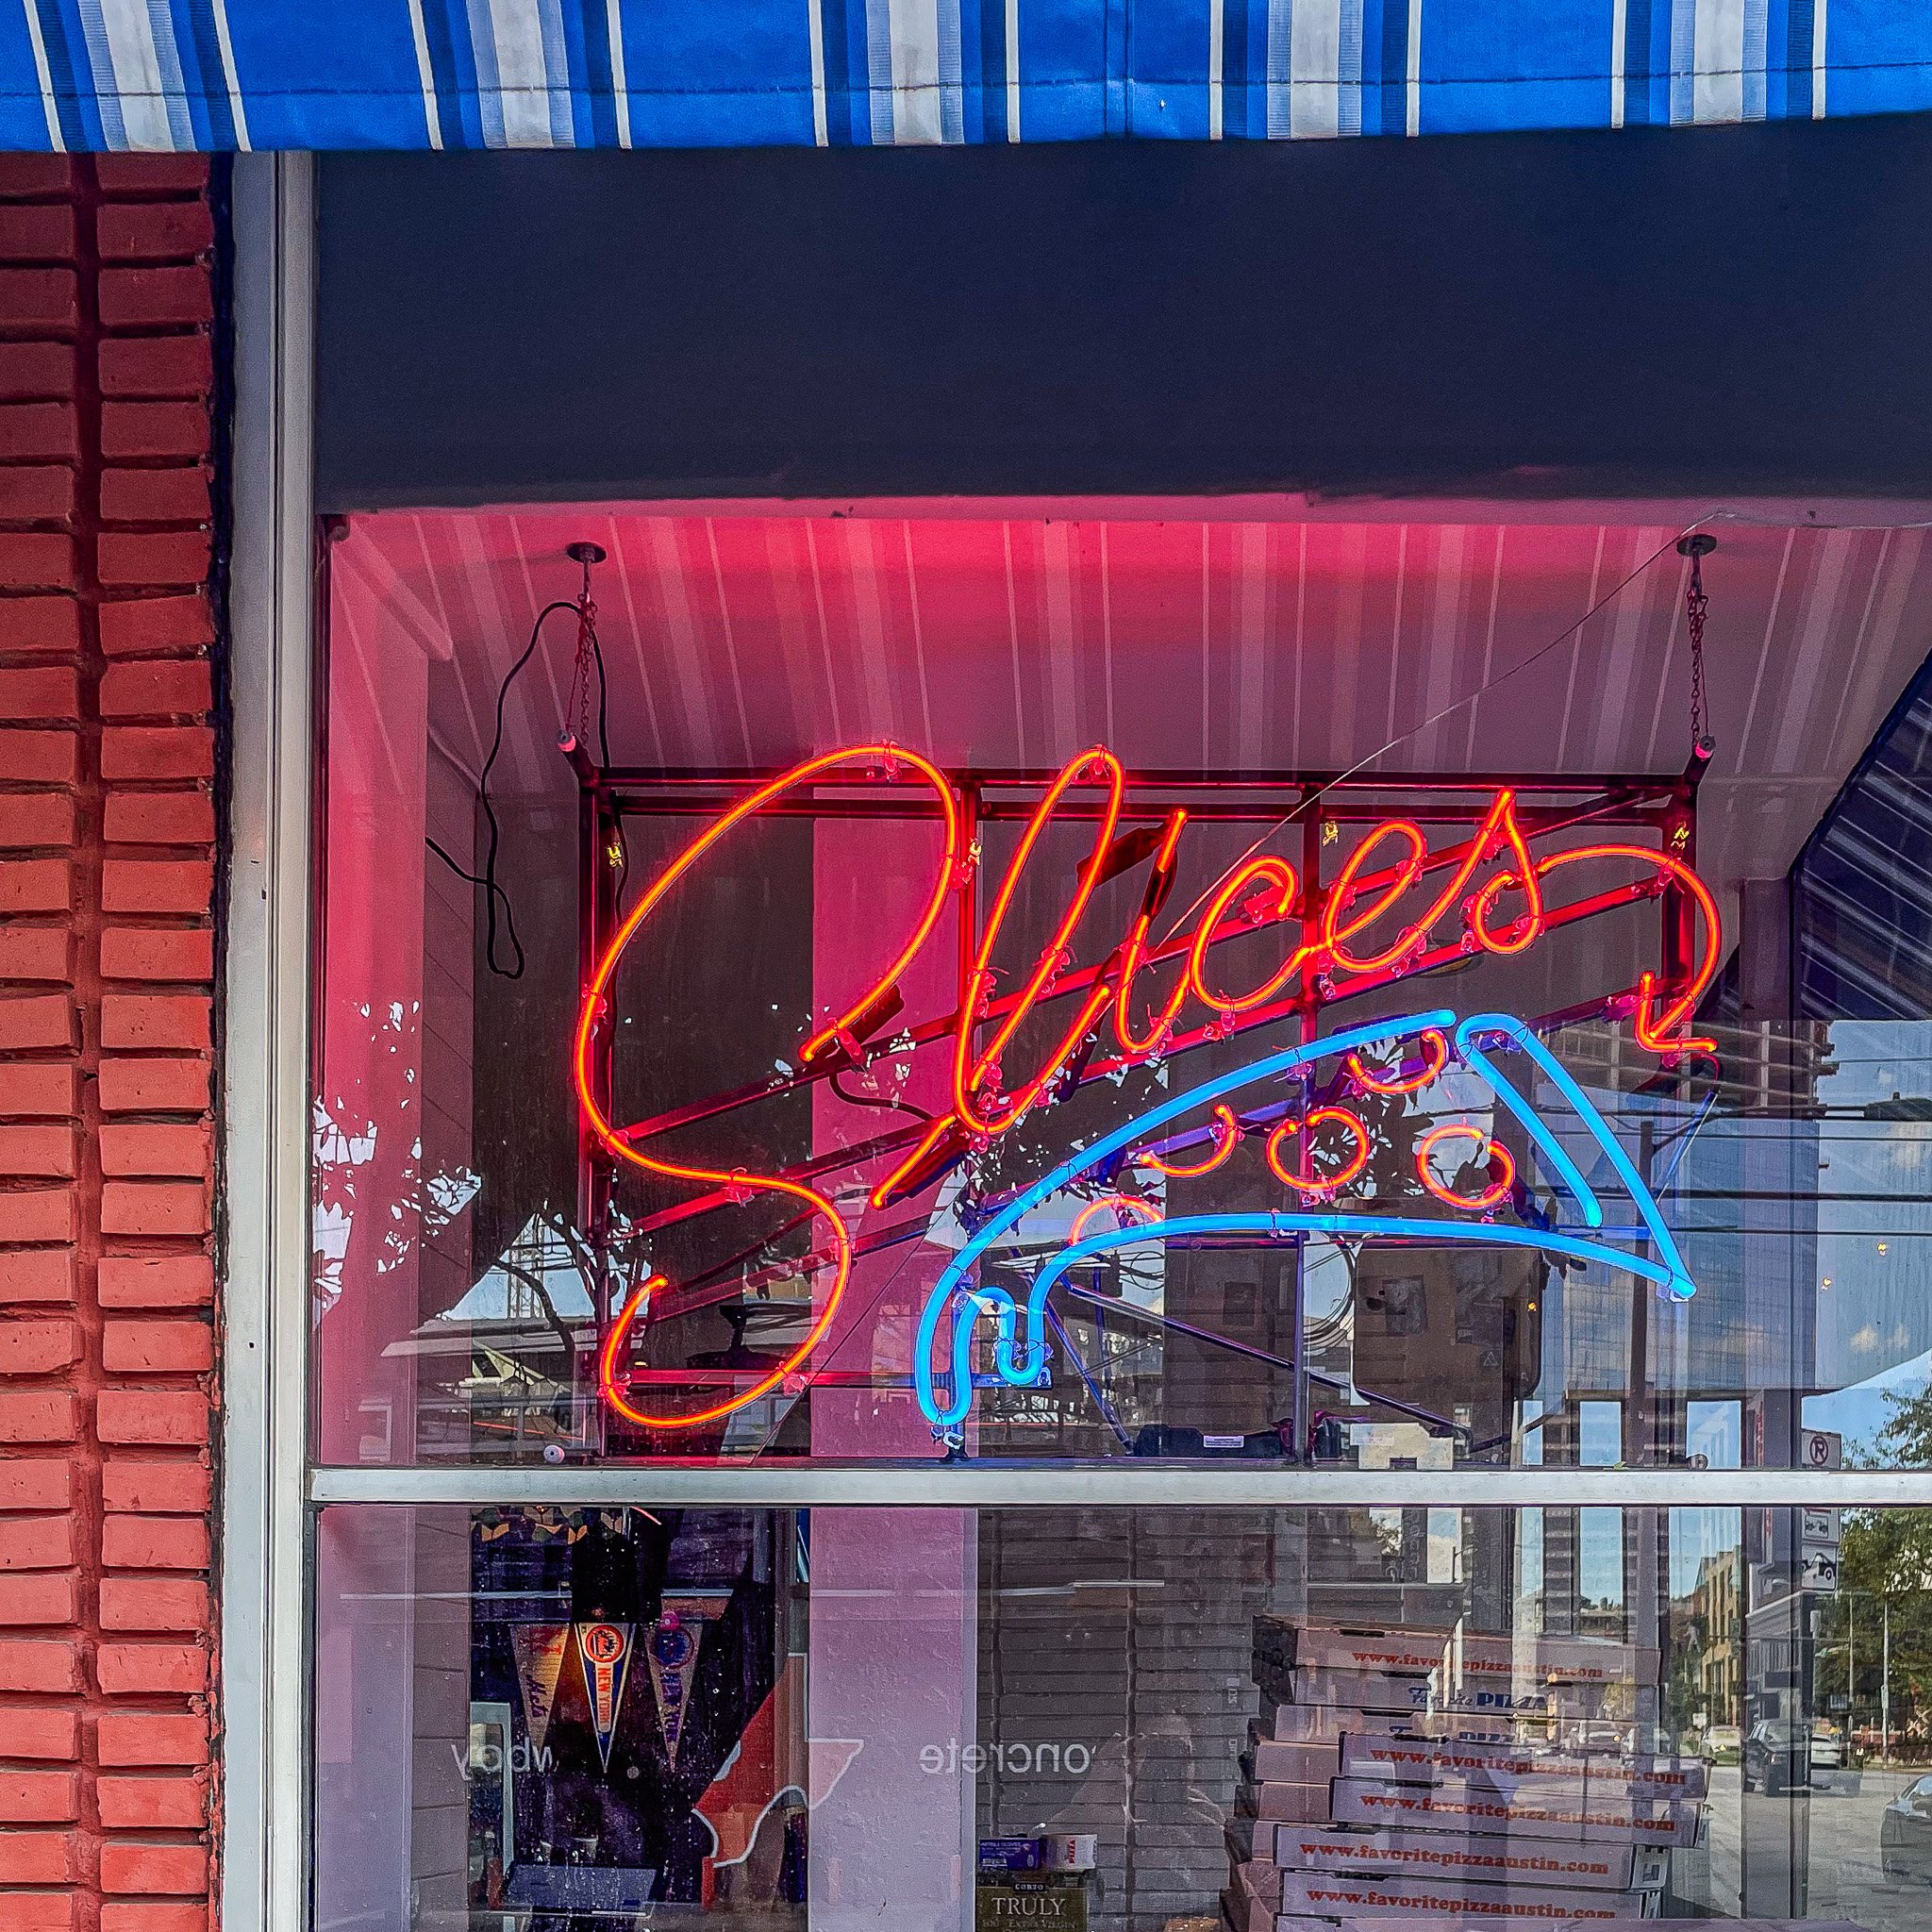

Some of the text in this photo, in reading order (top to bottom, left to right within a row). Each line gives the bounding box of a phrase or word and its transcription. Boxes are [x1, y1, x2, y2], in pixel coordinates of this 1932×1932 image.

[576, 742, 1544, 1428] Slices
[597, 1668, 612, 1725] NEW YORK
[1371, 1749, 1686, 1785] www.favoritepizzaaustin.com
[1360, 1795, 1675, 1831] www.favoritepizzaaustin.com
[1299, 1843, 1609, 1874] www.favoritepizzaaustin.com
[991, 1896, 1067, 1917] TRULY
[1306, 1890, 1616, 1919] www.favoritepizzaaustin.com
